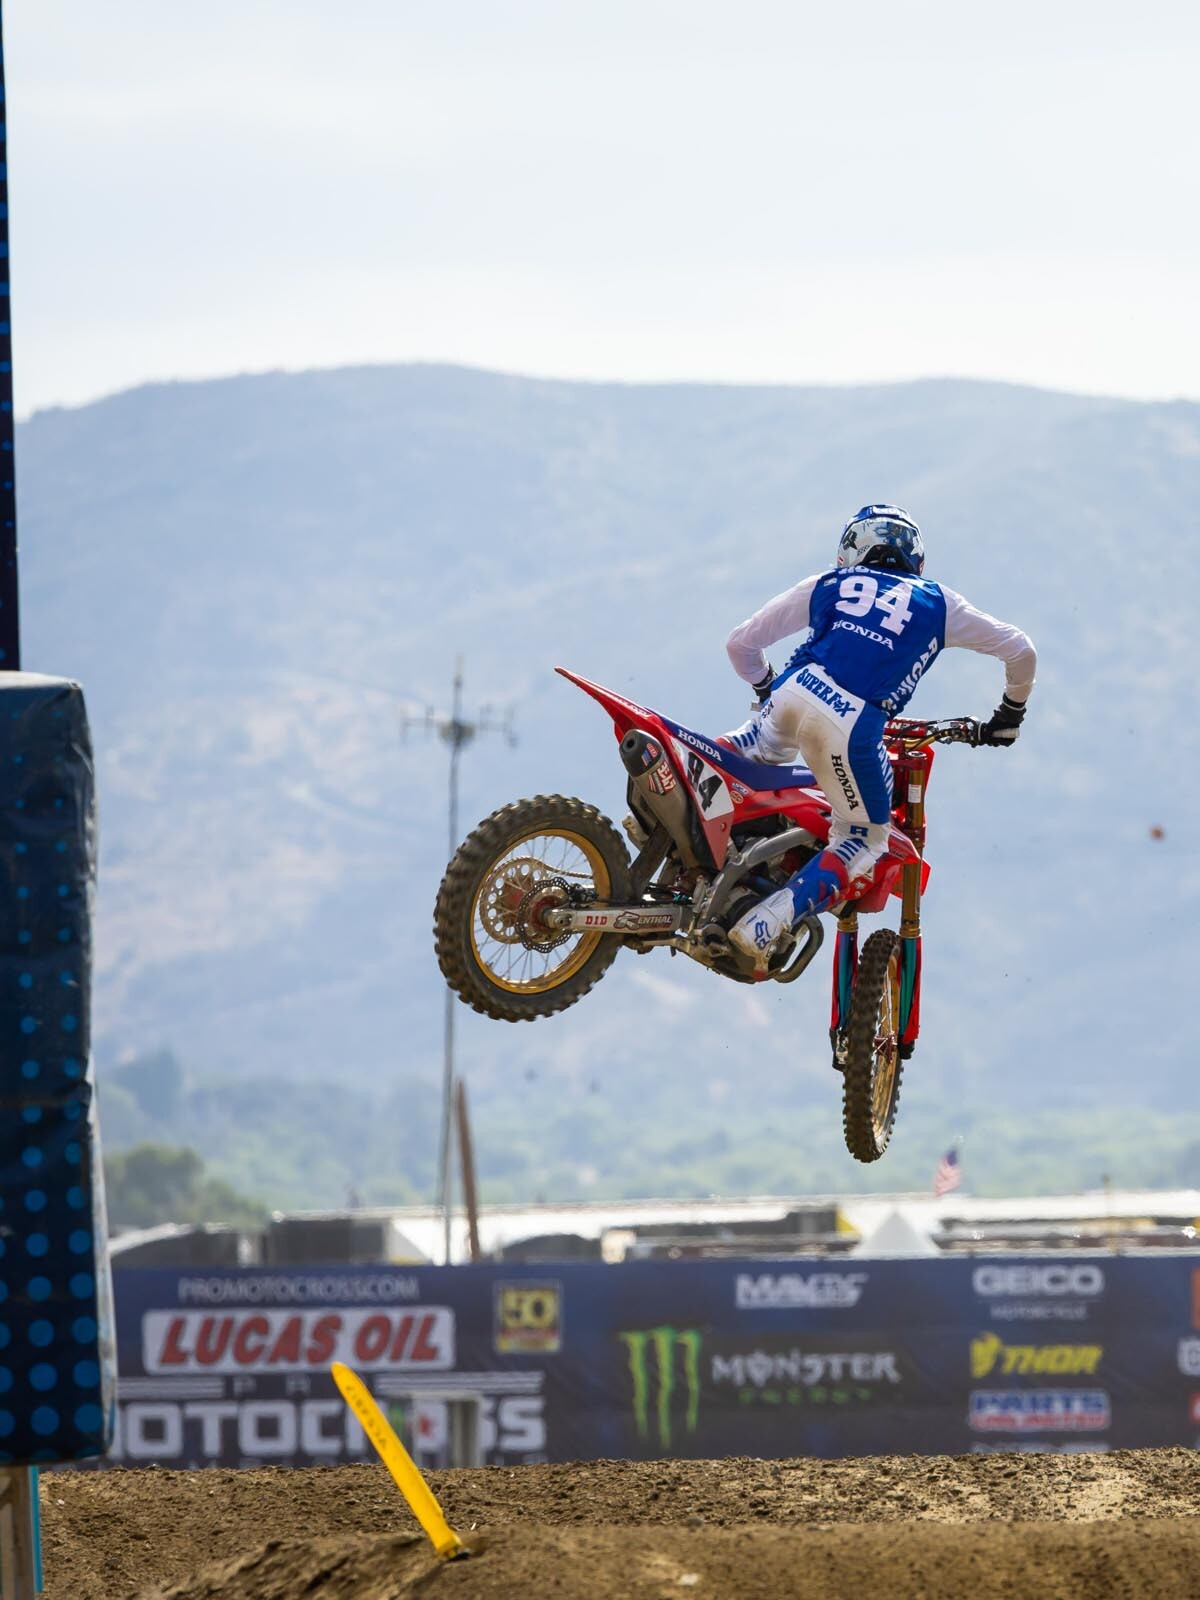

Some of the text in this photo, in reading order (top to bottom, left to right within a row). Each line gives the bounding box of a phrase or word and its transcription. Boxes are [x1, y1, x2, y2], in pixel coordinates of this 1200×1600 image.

[835, 575, 914, 636] 94
[831, 620, 895, 651] HONDA
[678, 729, 722, 761] HONDA
[831, 754, 860, 811] HONDA
[972, 1264, 1104, 1297] GEICO
[159, 1314, 343, 1365] LUCAS
[353, 1312, 440, 1363] OIL
[712, 1349, 901, 1387] MONSTER
[1001, 1344, 1103, 1375] THOR
